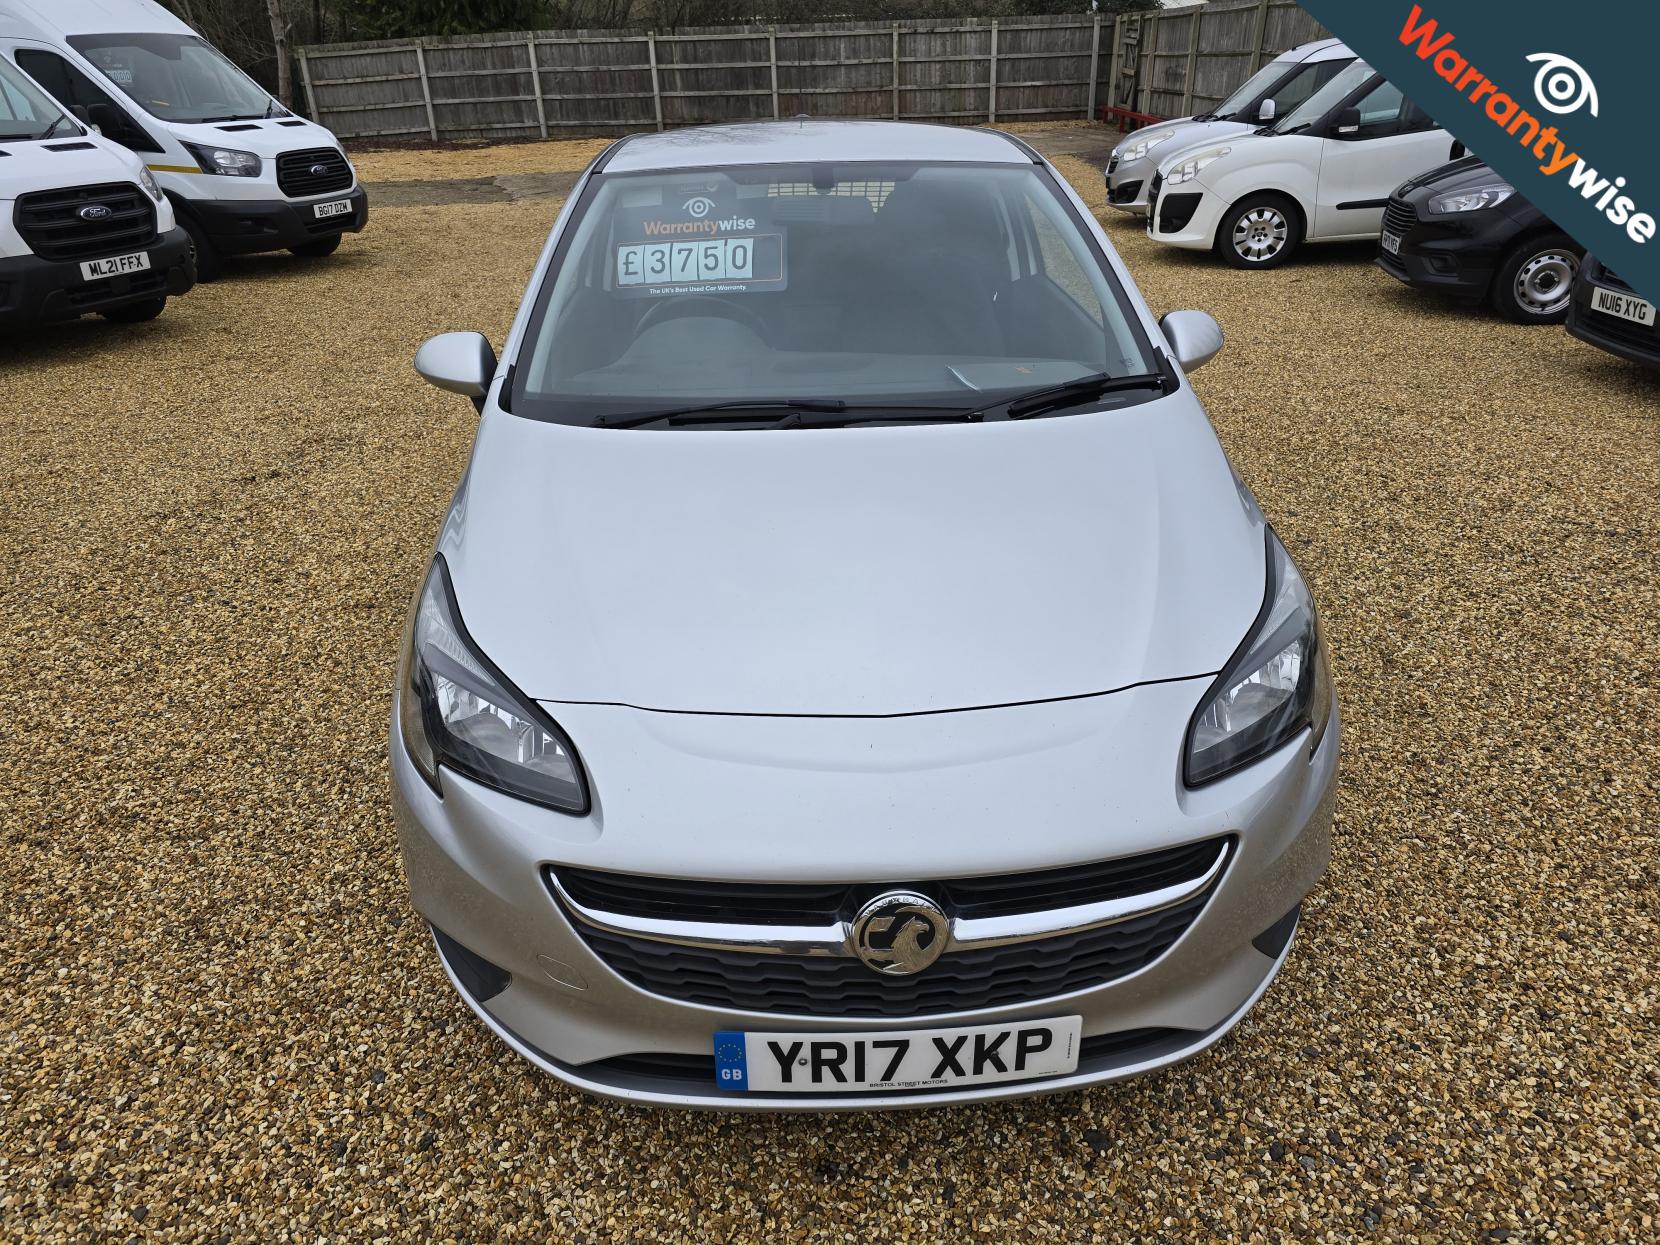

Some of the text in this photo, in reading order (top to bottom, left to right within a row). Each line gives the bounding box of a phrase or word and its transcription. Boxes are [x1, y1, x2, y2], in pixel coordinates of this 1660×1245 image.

[318, 205, 332, 216] BG17
[643, 216, 755, 235] Warrantywise
[88, 254, 143, 277] ML21 FFX
[623, 244, 748, 276] £3750
[1598, 292, 1647, 320] NU16 XYG
[767, 1040, 909, 1083] YR17
[930, 1027, 1053, 1079] XKP
[721, 1069, 742, 1080] GB
